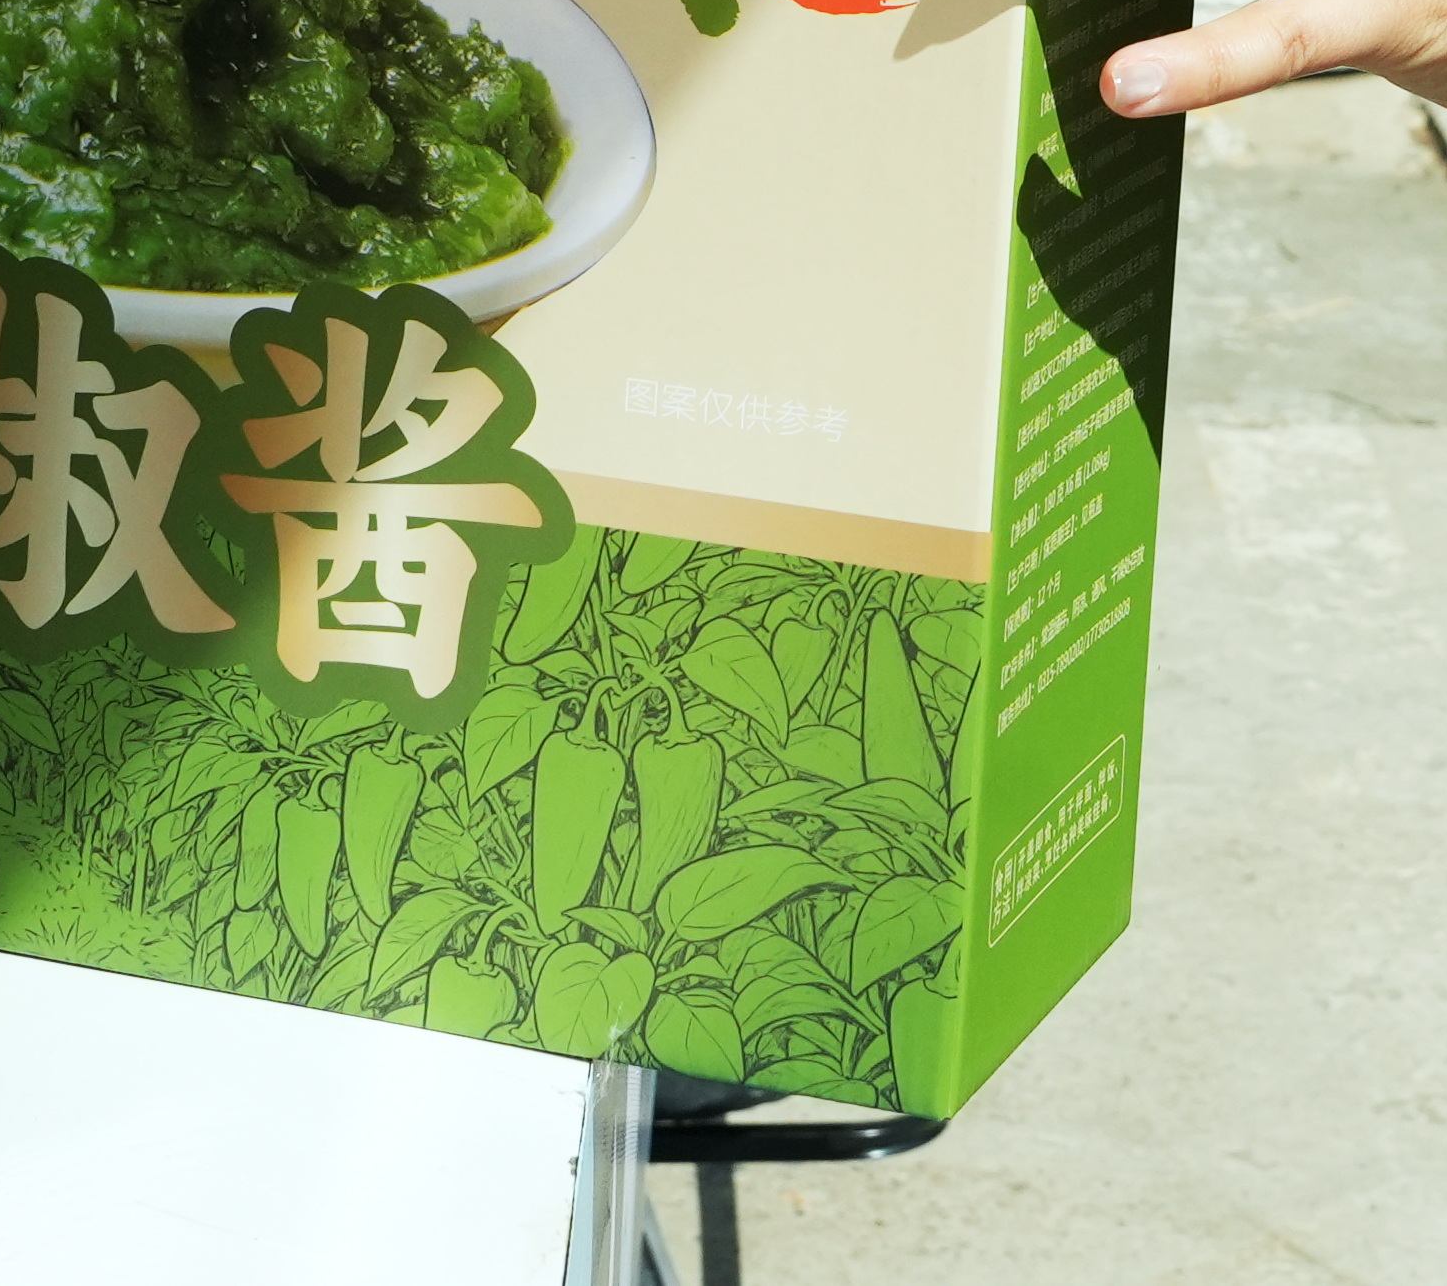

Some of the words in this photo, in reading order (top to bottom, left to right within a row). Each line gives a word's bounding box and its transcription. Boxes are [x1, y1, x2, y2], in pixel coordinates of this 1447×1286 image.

[625, 377, 849, 443] 图案仅供参考
